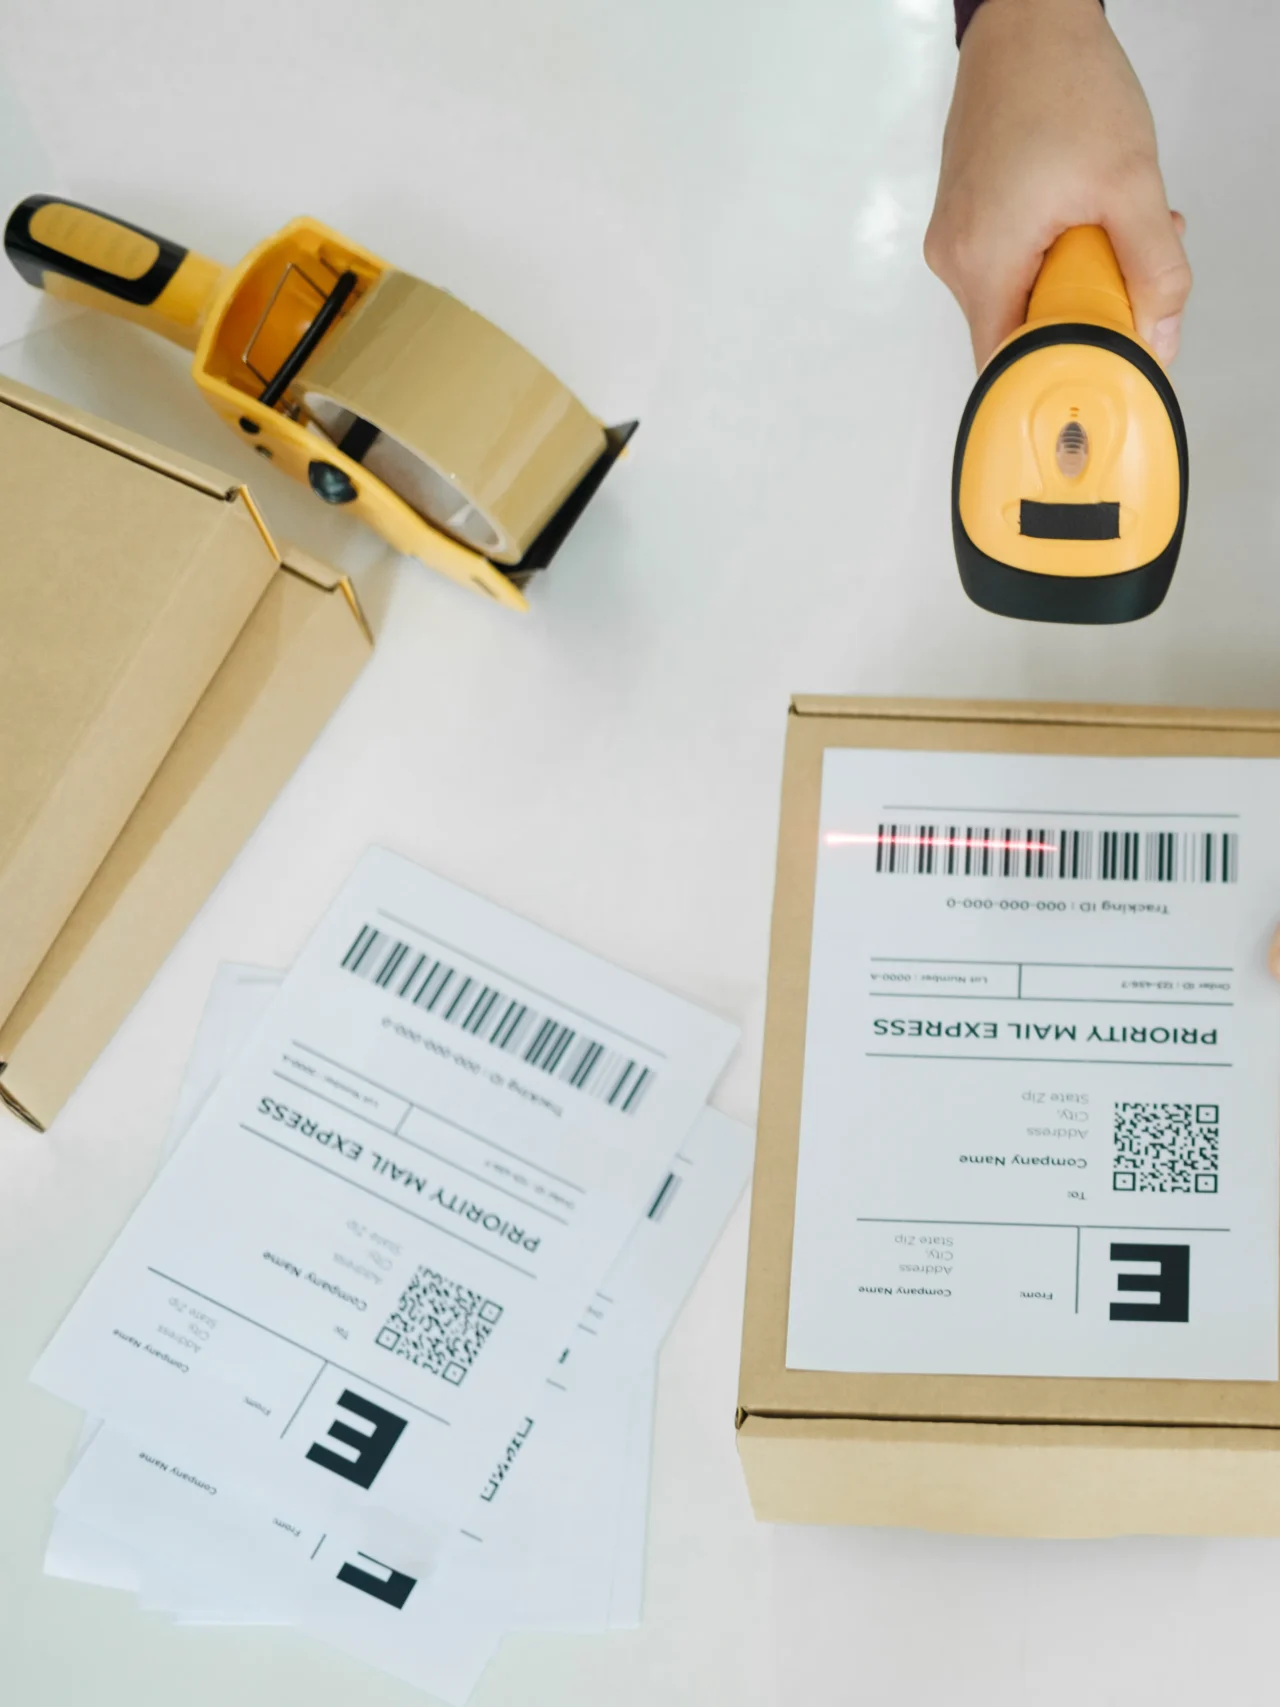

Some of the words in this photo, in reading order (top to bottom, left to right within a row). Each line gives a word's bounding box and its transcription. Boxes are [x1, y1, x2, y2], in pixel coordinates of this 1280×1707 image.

[947, 899, 1066, 911] 000-000-000-0
[1080, 902, 1096, 912] ID
[1102, 900, 1168, 914] Tracking
[870, 974, 911, 982] 0000-A
[922, 975, 966, 983] Number
[874, 1020, 997, 1038] EXPRESS
[1008, 1024, 1076, 1040] MAIL
[1088, 1026, 1217, 1044] PRIORITY
[1022, 1090, 1046, 1103] Zip
[1050, 1094, 1088, 1104] State
[258, 1098, 363, 1160] EXPRESS
[1027, 1128, 1088, 1139] Address
[960, 1156, 1005, 1166] Name
[1012, 1155, 1087, 1168] Company
[373, 1154, 426, 1192] MAIL
[1068, 1192, 1085, 1200] To:
[432, 1188, 540, 1252] PRIORITY
[894, 1234, 915, 1245] Zip
[920, 1237, 953, 1246] State
[263, 1252, 301, 1277] Name
[900, 1265, 952, 1274] Address
[1110, 1243, 1190, 1322] E
[306, 1272, 367, 1310] Company
[896, 1287, 951, 1296] Company
[1020, 1292, 1052, 1300] From:
[113, 1330, 142, 1348] Name
[144, 1344, 189, 1373] Company
[305, 1389, 408, 1490] E
[139, 1453, 168, 1471] Name
[170, 1467, 217, 1495] Company
